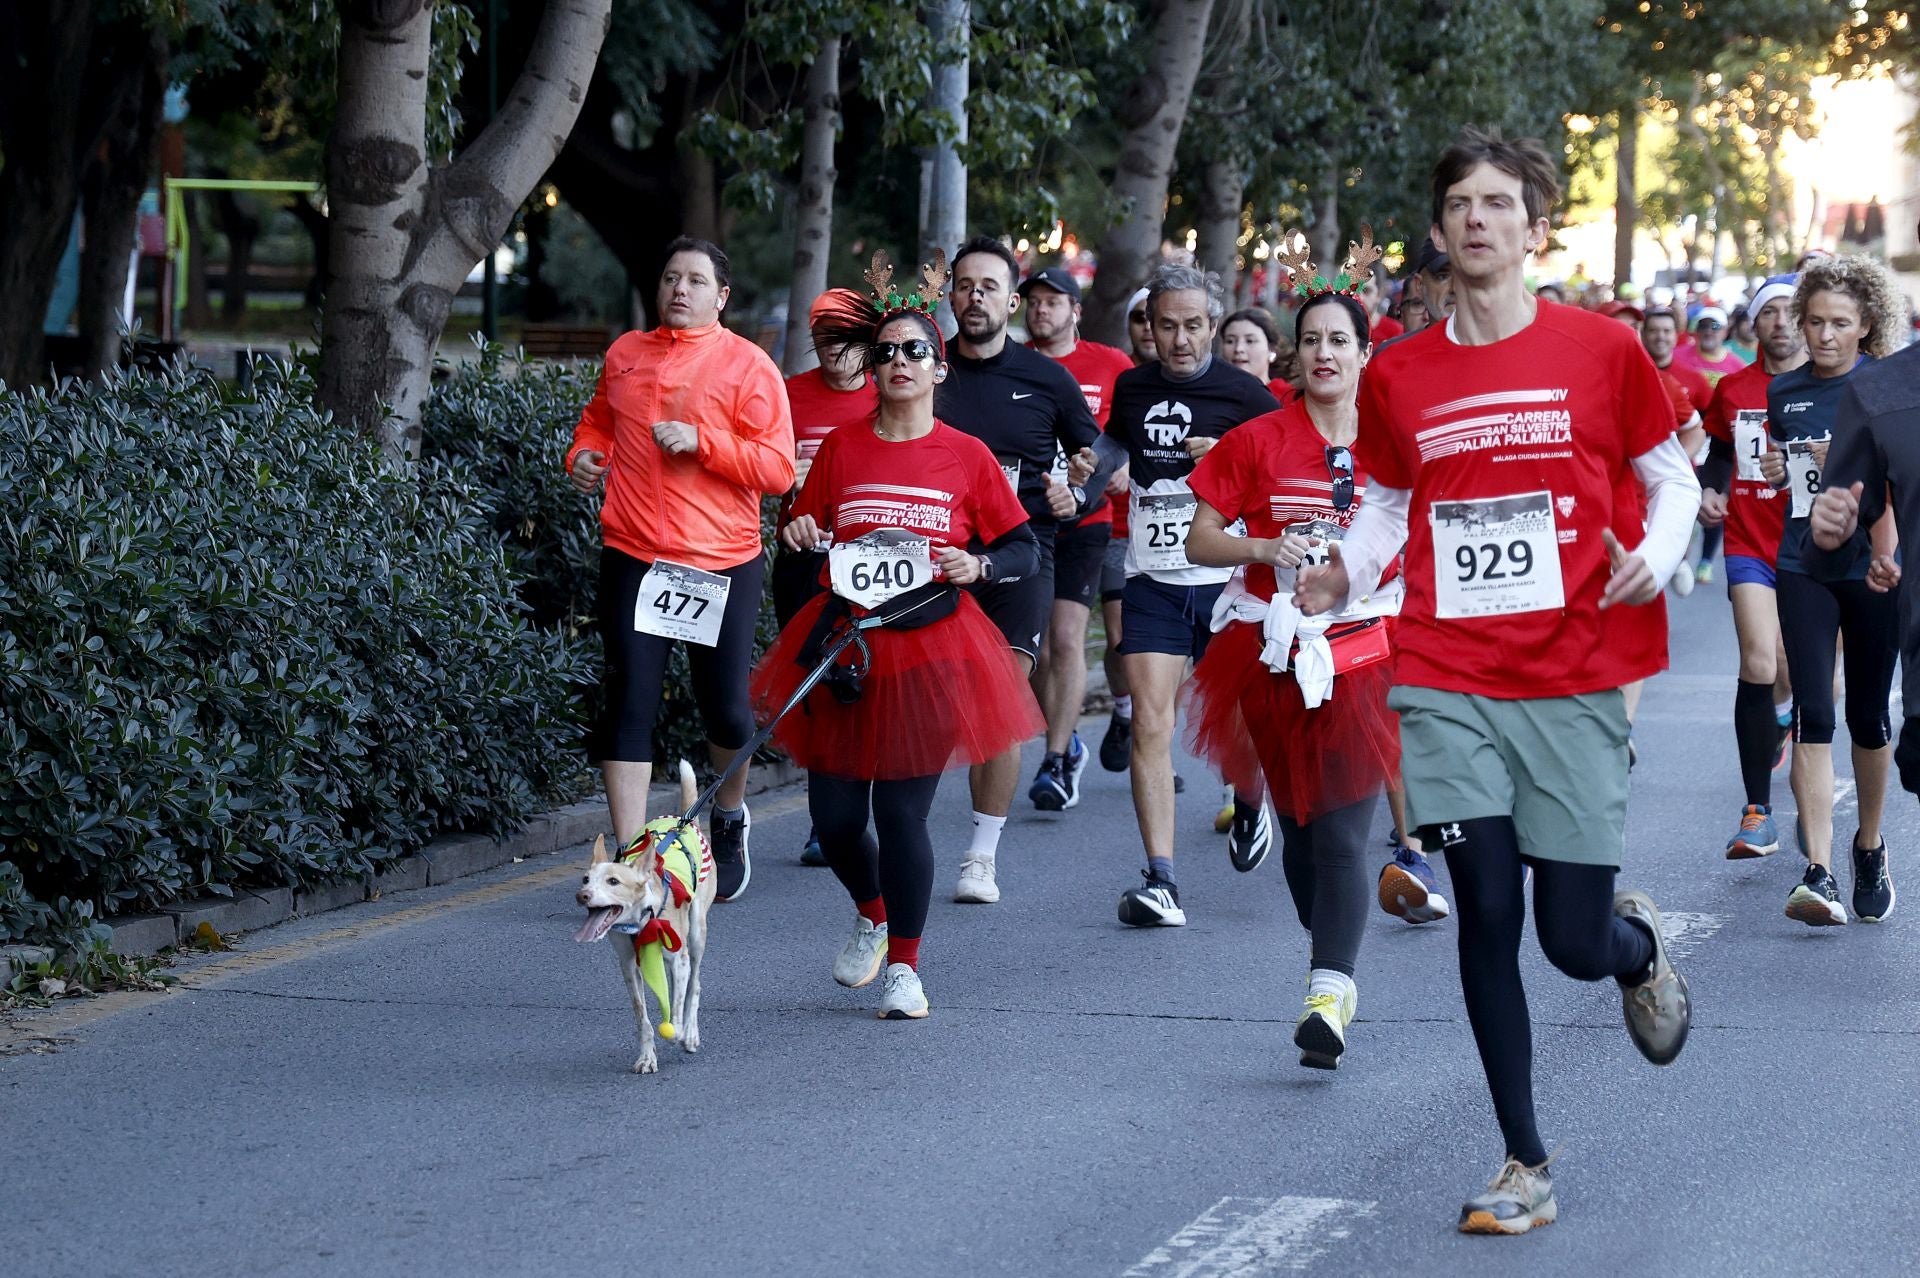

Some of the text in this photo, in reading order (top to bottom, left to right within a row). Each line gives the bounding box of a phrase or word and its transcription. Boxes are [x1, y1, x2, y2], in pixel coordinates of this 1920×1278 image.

[1549, 389, 1569, 402] XIV
[1504, 410, 1571, 425] CARRERA
[1485, 421, 1571, 437] SAN SILVESTRE
[1455, 431, 1572, 453] PALMA PALMILLA
[1517, 453, 1540, 461] CIUDAD
[1540, 451, 1573, 460] SALUDABLE
[940, 491, 954, 502] XIV
[886, 509, 951, 523] SAN SILVESTRE
[904, 503, 952, 517] CARRERA
[1512, 509, 1550, 521] XIV
[860, 514, 951, 533] PALMA PALMILLA
[1455, 540, 1534, 582] 929
[851, 560, 914, 591] 640
[653, 590, 709, 620] 477
